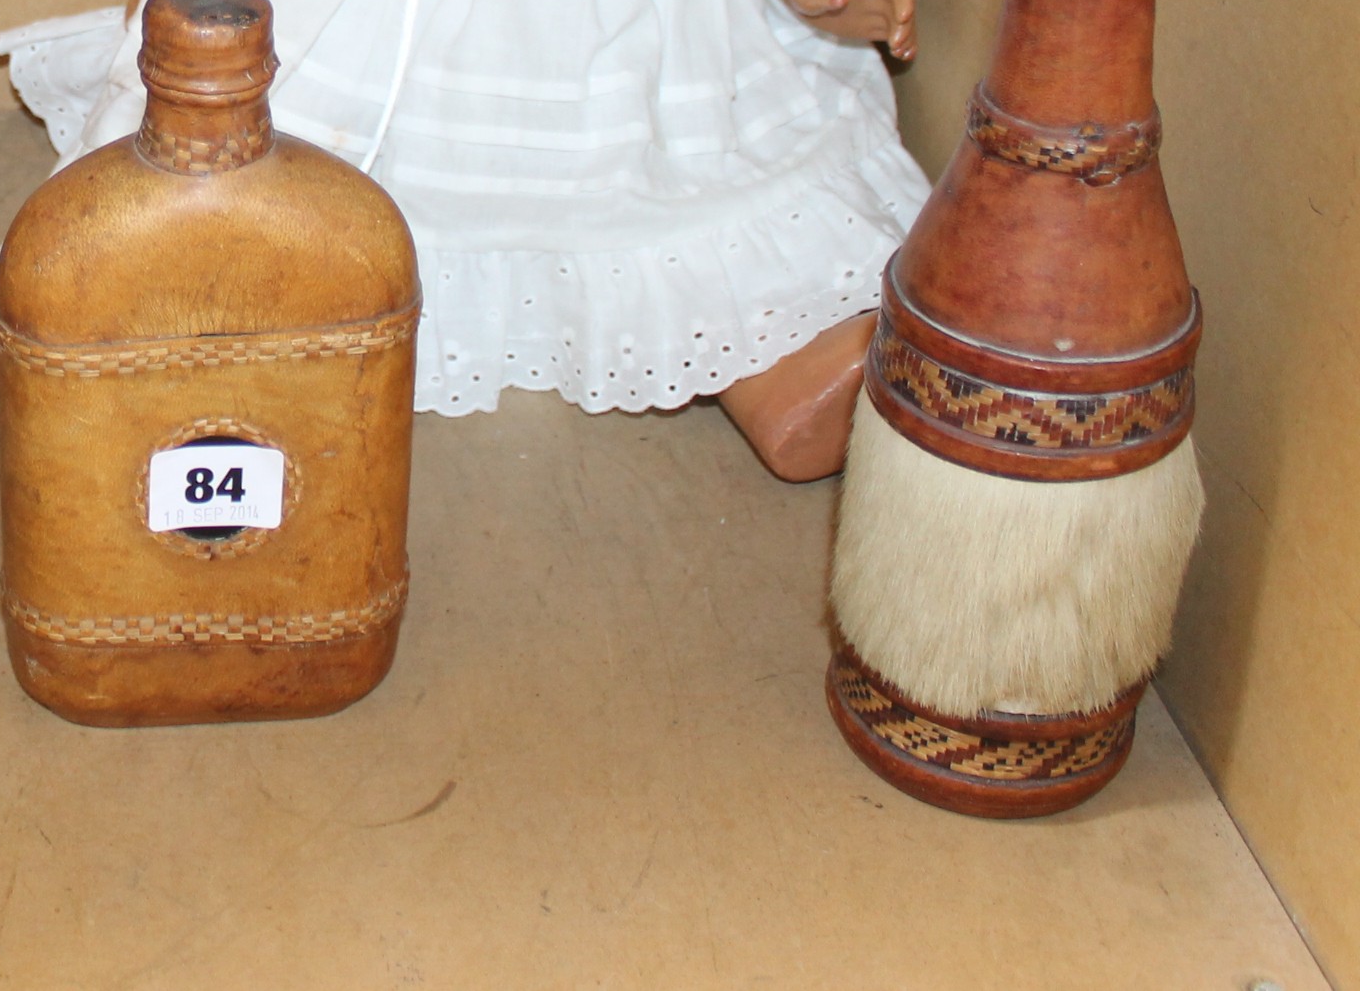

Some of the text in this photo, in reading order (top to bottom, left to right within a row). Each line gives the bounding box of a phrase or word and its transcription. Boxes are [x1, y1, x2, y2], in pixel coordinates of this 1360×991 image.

[184, 467, 246, 504] 84
[193, 506, 223, 523] SEP
[230, 505, 259, 521] 2014
